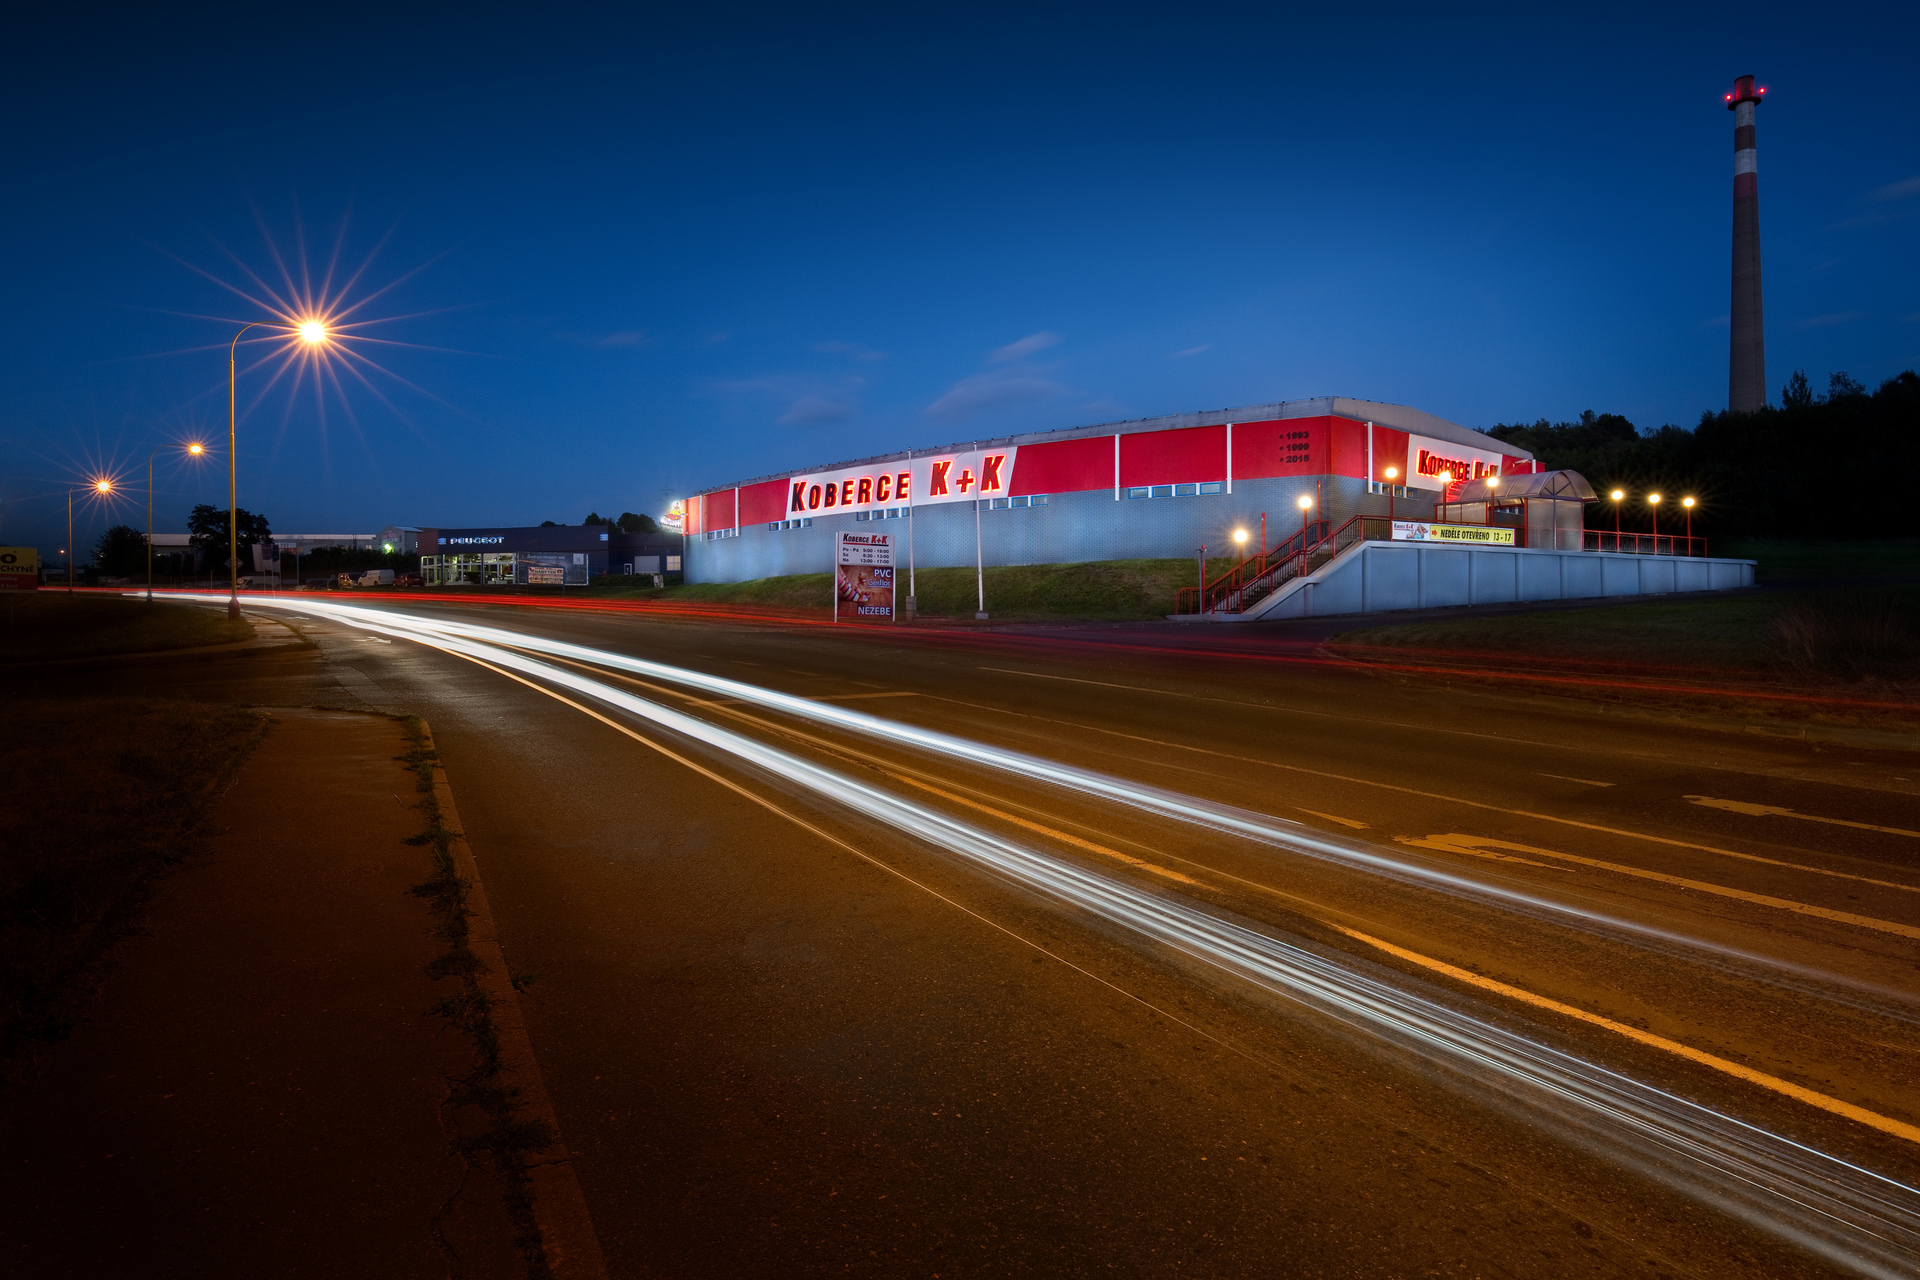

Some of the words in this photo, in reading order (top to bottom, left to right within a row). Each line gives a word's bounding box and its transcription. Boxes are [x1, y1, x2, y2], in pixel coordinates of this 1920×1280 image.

[1286, 455, 1309, 463] 2015
[791, 472, 910, 512] KOBERCE
[929, 455, 1005, 496] K+K
[843, 533, 869, 543] KOBERCE
[871, 535, 888, 544] K+K
[1440, 528, 1460, 539] NEDĚLE
[1462, 529, 1490, 540] OTEVŘENO
[1493, 532, 1500, 541] 13
[1504, 533, 1512, 542] 17
[450, 536, 505, 545] PEUGEOT
[1, 564, 34, 572] CHYNĚ
[874, 569, 891, 578] PVC
[858, 606, 891, 616] NEZEBE
